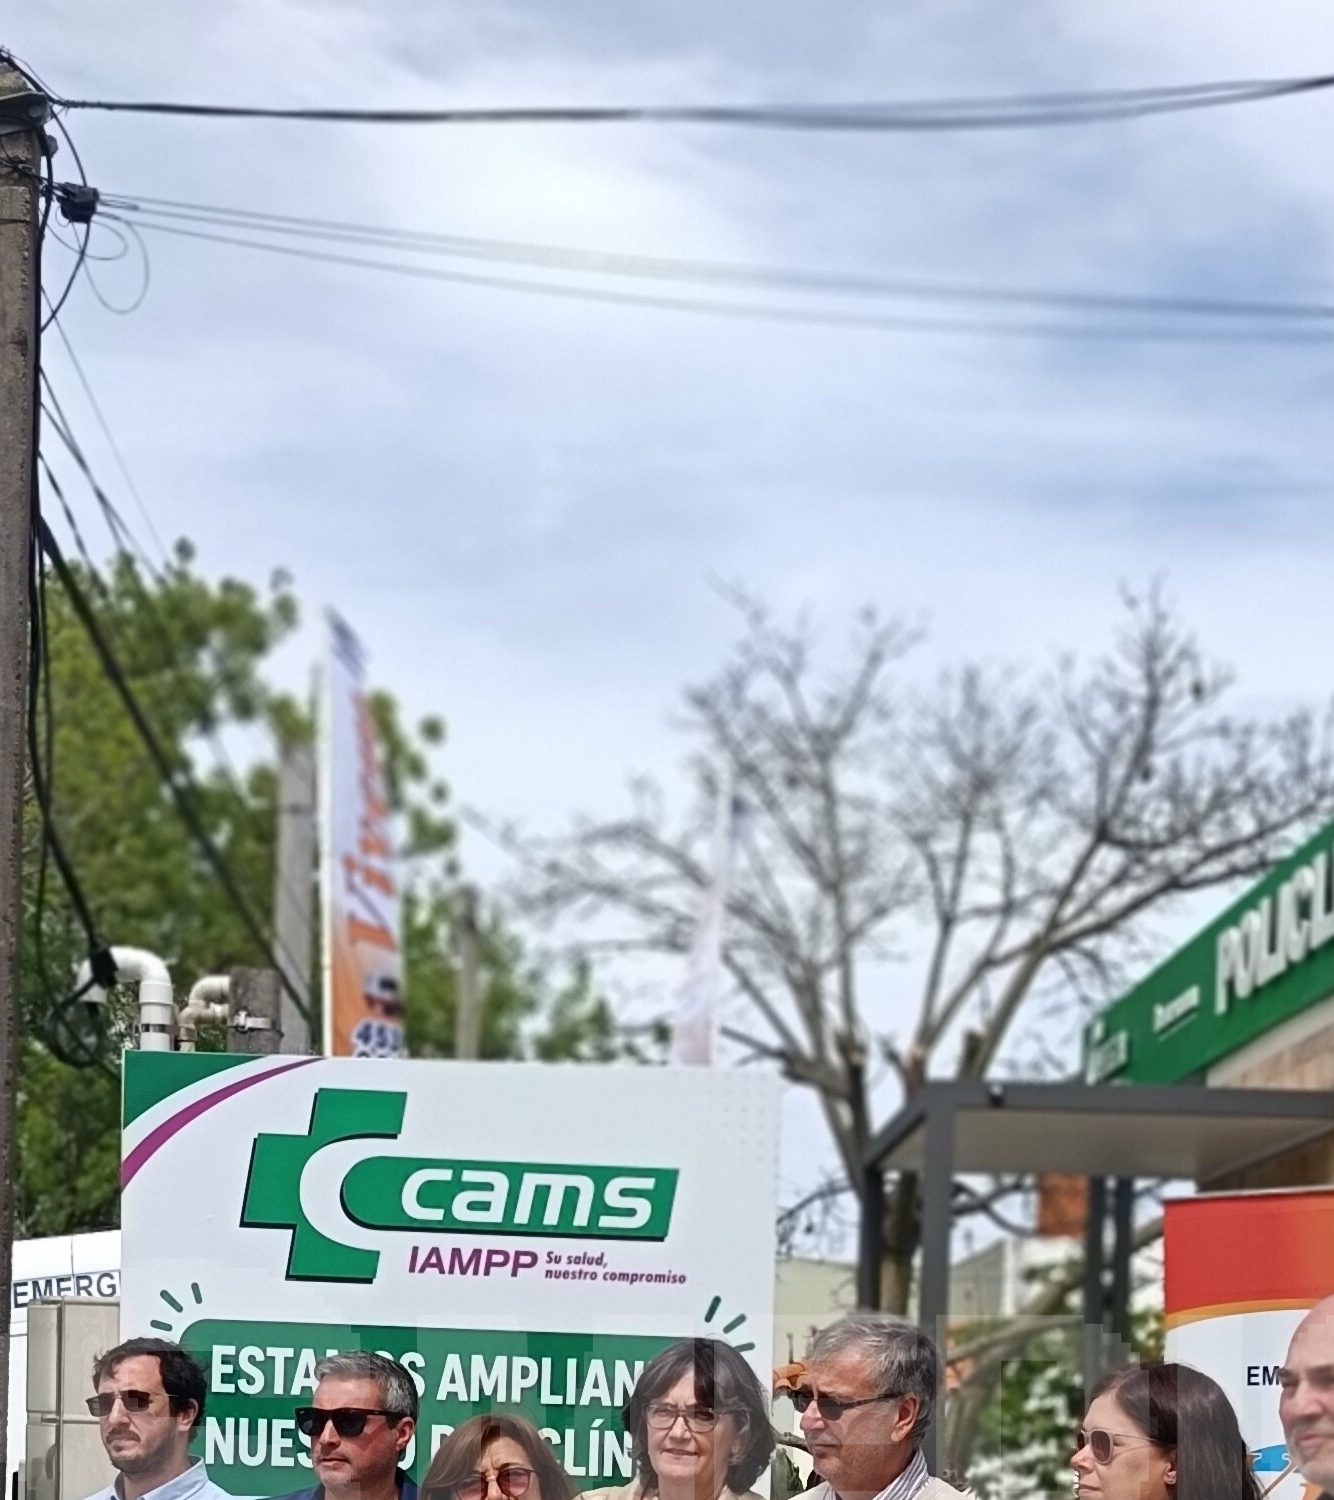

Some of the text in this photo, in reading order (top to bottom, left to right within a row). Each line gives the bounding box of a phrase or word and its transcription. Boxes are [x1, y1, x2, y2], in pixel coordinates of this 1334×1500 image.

[401, 1168, 656, 1229] cams
[408, 1246, 538, 1278] IAMPP
[544, 1251, 609, 1268] Su salud,
[544, 1268, 687, 1285] nuestro compromiso
[211, 1344, 653, 1407] ESTAS AMPLIAN
